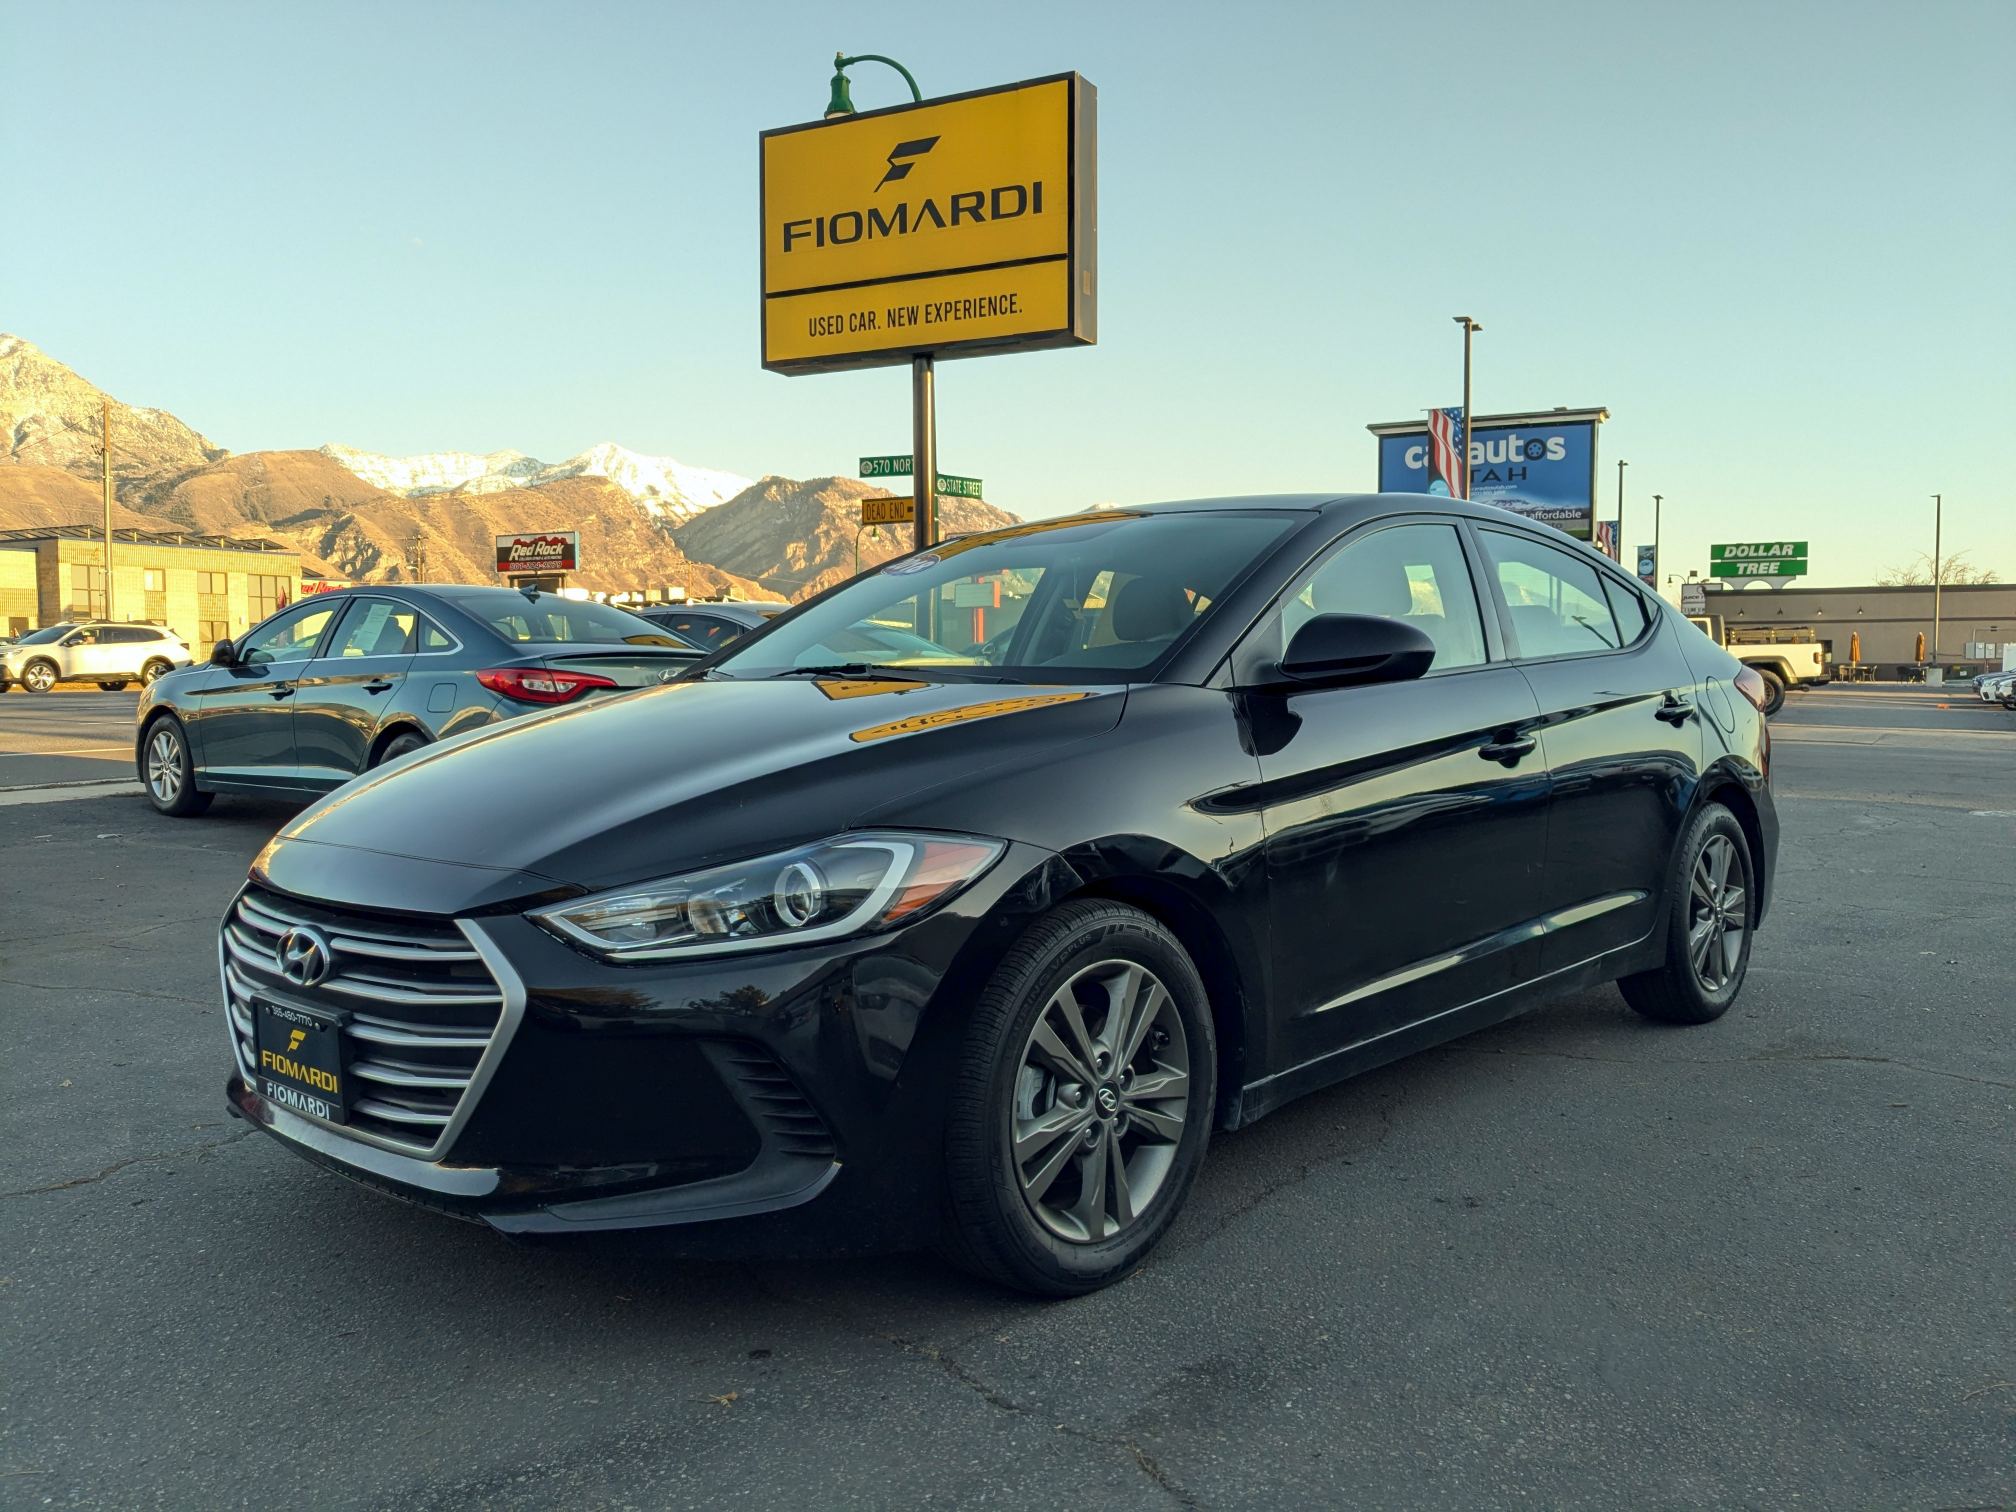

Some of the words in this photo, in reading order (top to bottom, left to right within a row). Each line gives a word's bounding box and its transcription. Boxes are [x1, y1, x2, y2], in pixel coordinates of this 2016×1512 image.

[783, 181, 1043, 253] FIOMARDI
[809, 314, 844, 337] USED
[849, 310, 881, 333] CAR.
[887, 305, 920, 328] NEW
[925, 293, 1023, 324] EXPERIENCE.
[873, 460, 891, 474] 570
[893, 459, 914, 473] NOR
[1470, 466, 1527, 484] TAH
[946, 480, 962, 494] STATE
[963, 481, 982, 496] STREET
[866, 502, 886, 520] DEAD
[889, 501, 905, 519] END
[1530, 509, 1582, 520] affordable
[508, 543, 536, 561] Red
[534, 541, 565, 556] Rock
[1724, 543, 1795, 558] DOLLAR
[1736, 561, 1780, 575] TREE
[261, 1049, 338, 1094] FIOMARDI
[267, 1082, 330, 1120] FIOMARDI
